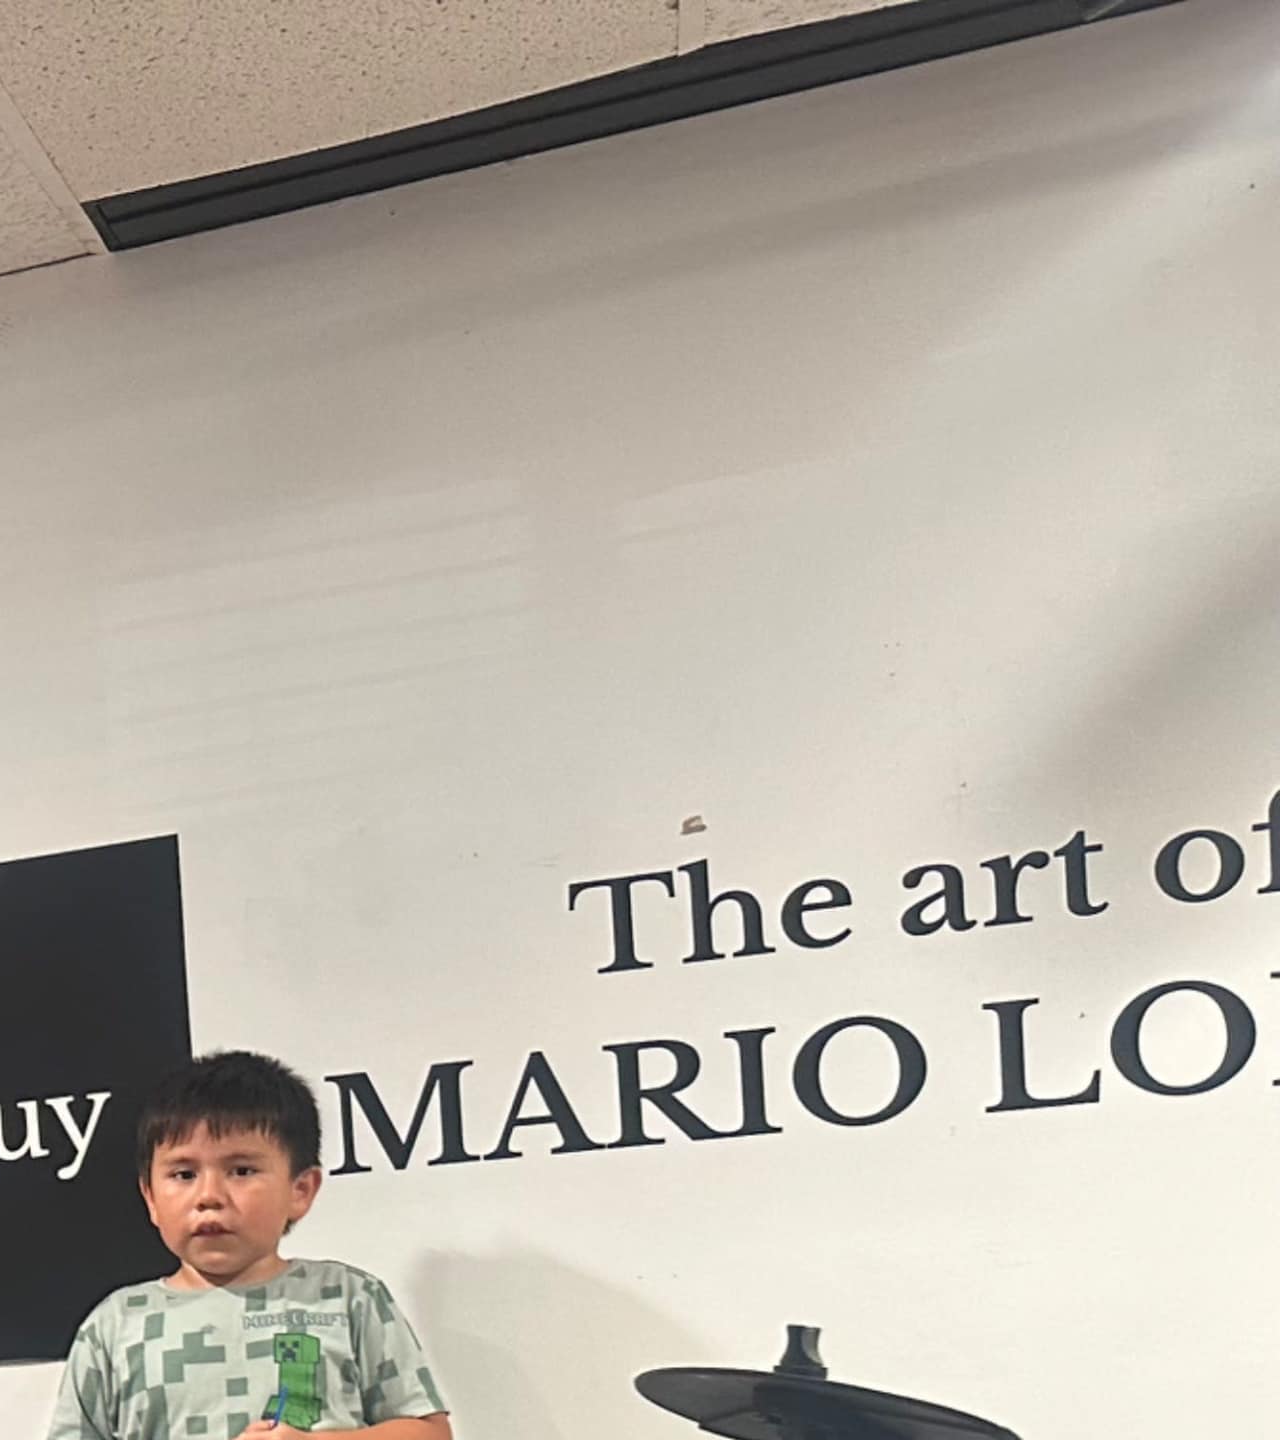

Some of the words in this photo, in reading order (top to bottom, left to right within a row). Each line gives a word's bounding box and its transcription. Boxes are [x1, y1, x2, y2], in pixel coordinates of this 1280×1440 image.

[569, 858, 852, 974] The
[901, 830, 1109, 938] art
[324, 1015, 928, 1176] MARIO
[982, 971, 1280, 1113] LO
